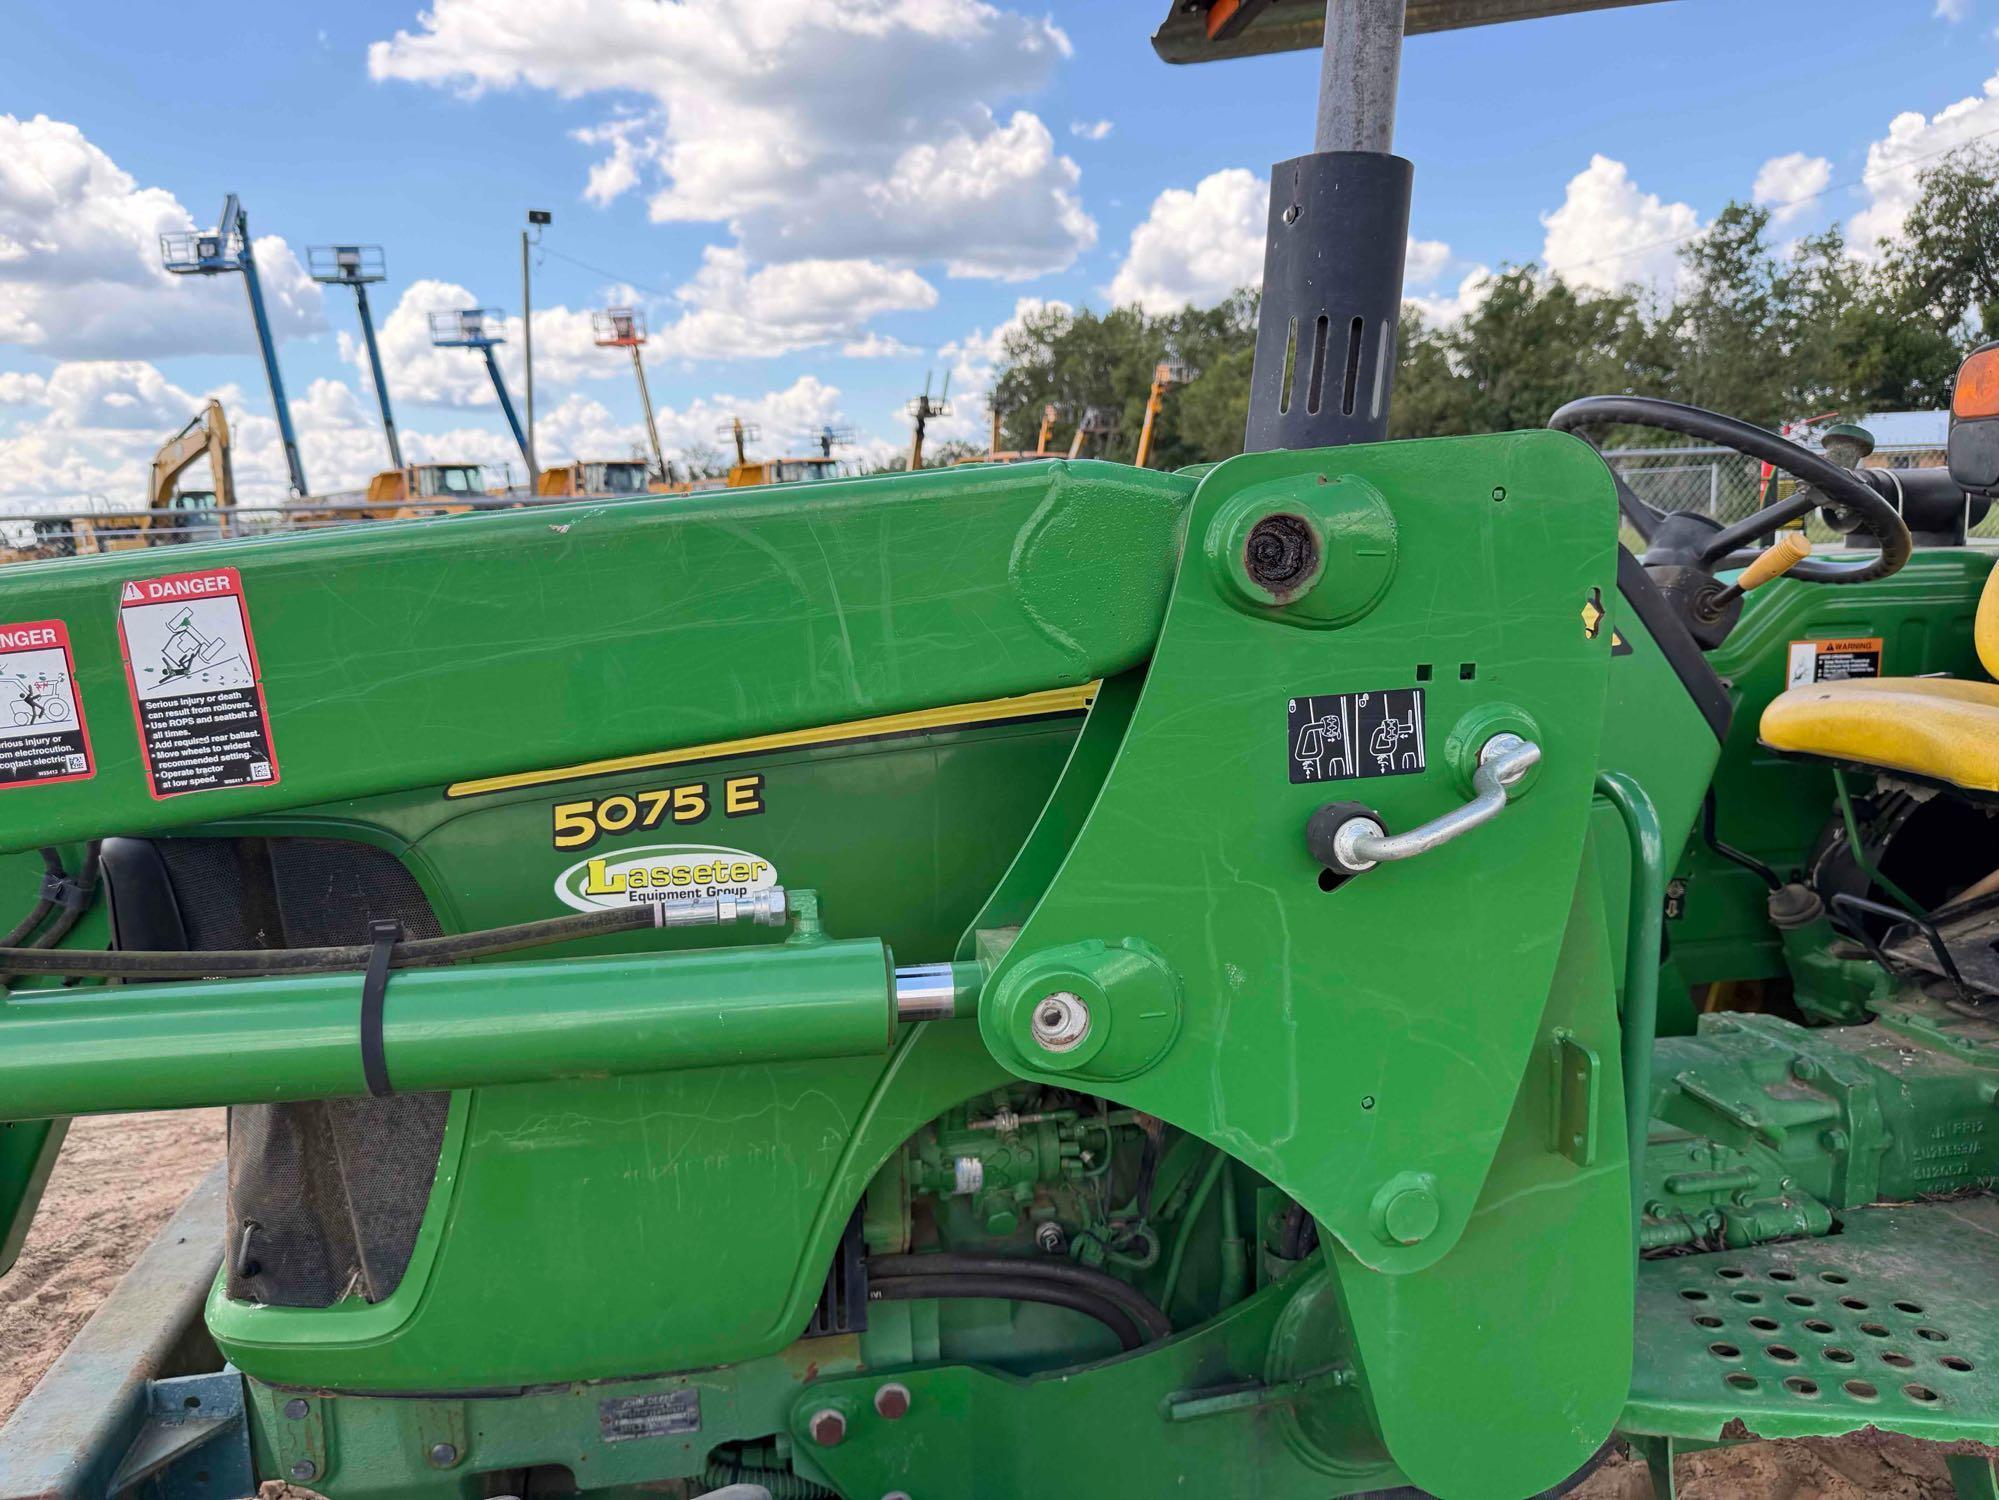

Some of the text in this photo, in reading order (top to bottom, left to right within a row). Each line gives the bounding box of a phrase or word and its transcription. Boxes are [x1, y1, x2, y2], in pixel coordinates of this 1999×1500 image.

[149, 576, 230, 597] DANGER
[0, 629, 57, 648] NGER
[145, 691, 242, 710] Serious injury or death
[148, 701, 252, 719] can result from rollovers.
[150, 709, 258, 729] Use ROPS and seatbelt at
[0, 740, 24, 749] rious
[25, 737, 50, 747] injury
[152, 729, 191, 739] all times.
[155, 729, 261, 749] Add required rear ballast.
[14, 745, 75, 758] electrocution.
[156, 750, 180, 759] Move
[181, 746, 211, 756] wheels
[223, 741, 252, 751] widest
[0, 755, 66, 770] contact electric
[158, 752, 252, 769] recommended setting.
[160, 765, 224, 780] Operate tractor
[162, 775, 218, 788] at low speed.
[553, 775, 762, 850] 5075 E
[586, 858, 768, 895] Lasseter
[629, 886, 747, 904] Equipment Group
